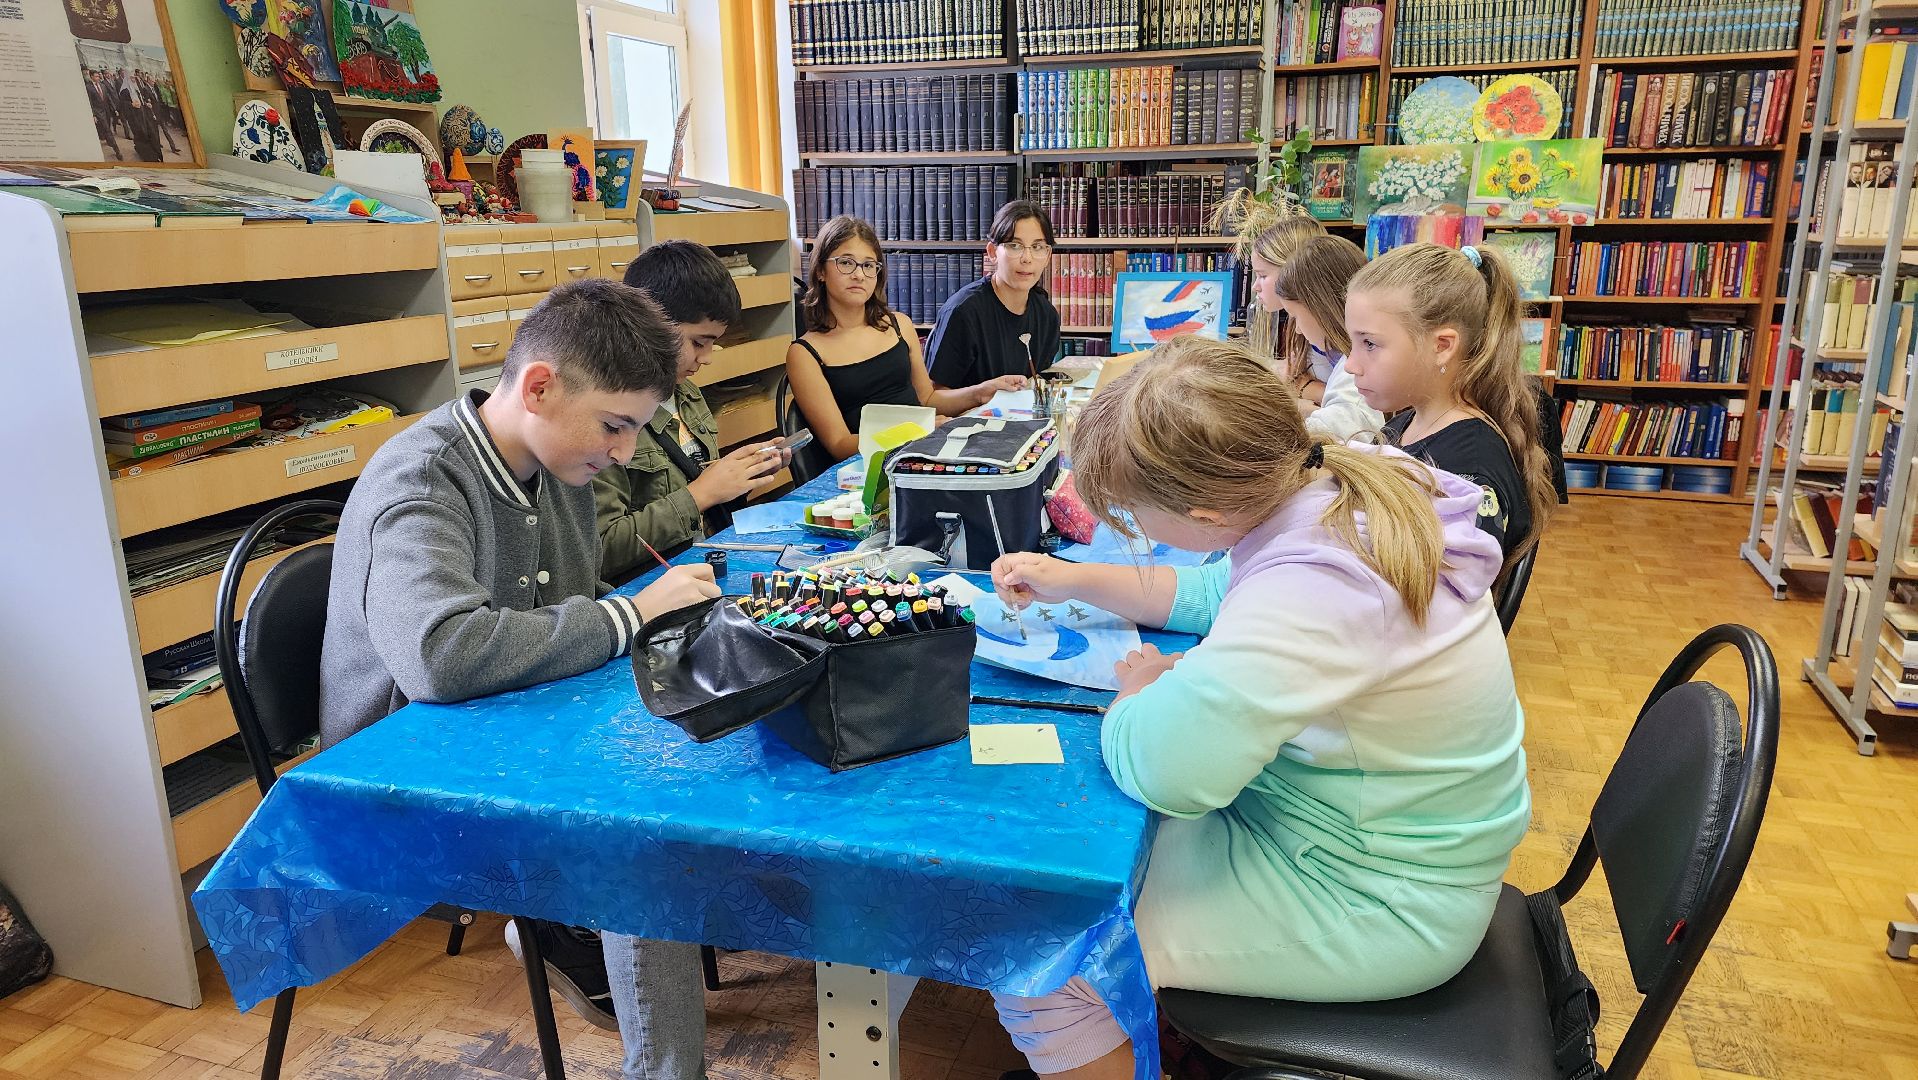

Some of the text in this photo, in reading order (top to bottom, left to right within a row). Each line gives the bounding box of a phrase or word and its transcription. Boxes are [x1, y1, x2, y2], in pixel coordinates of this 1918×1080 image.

[1658, 75, 1678, 144] ХРАМЫ РОССИИ
[1672, 75, 1692, 144] ХРАМЫ РОССИИ
[180, 426, 230, 446] ПЛАСТИЛИН
